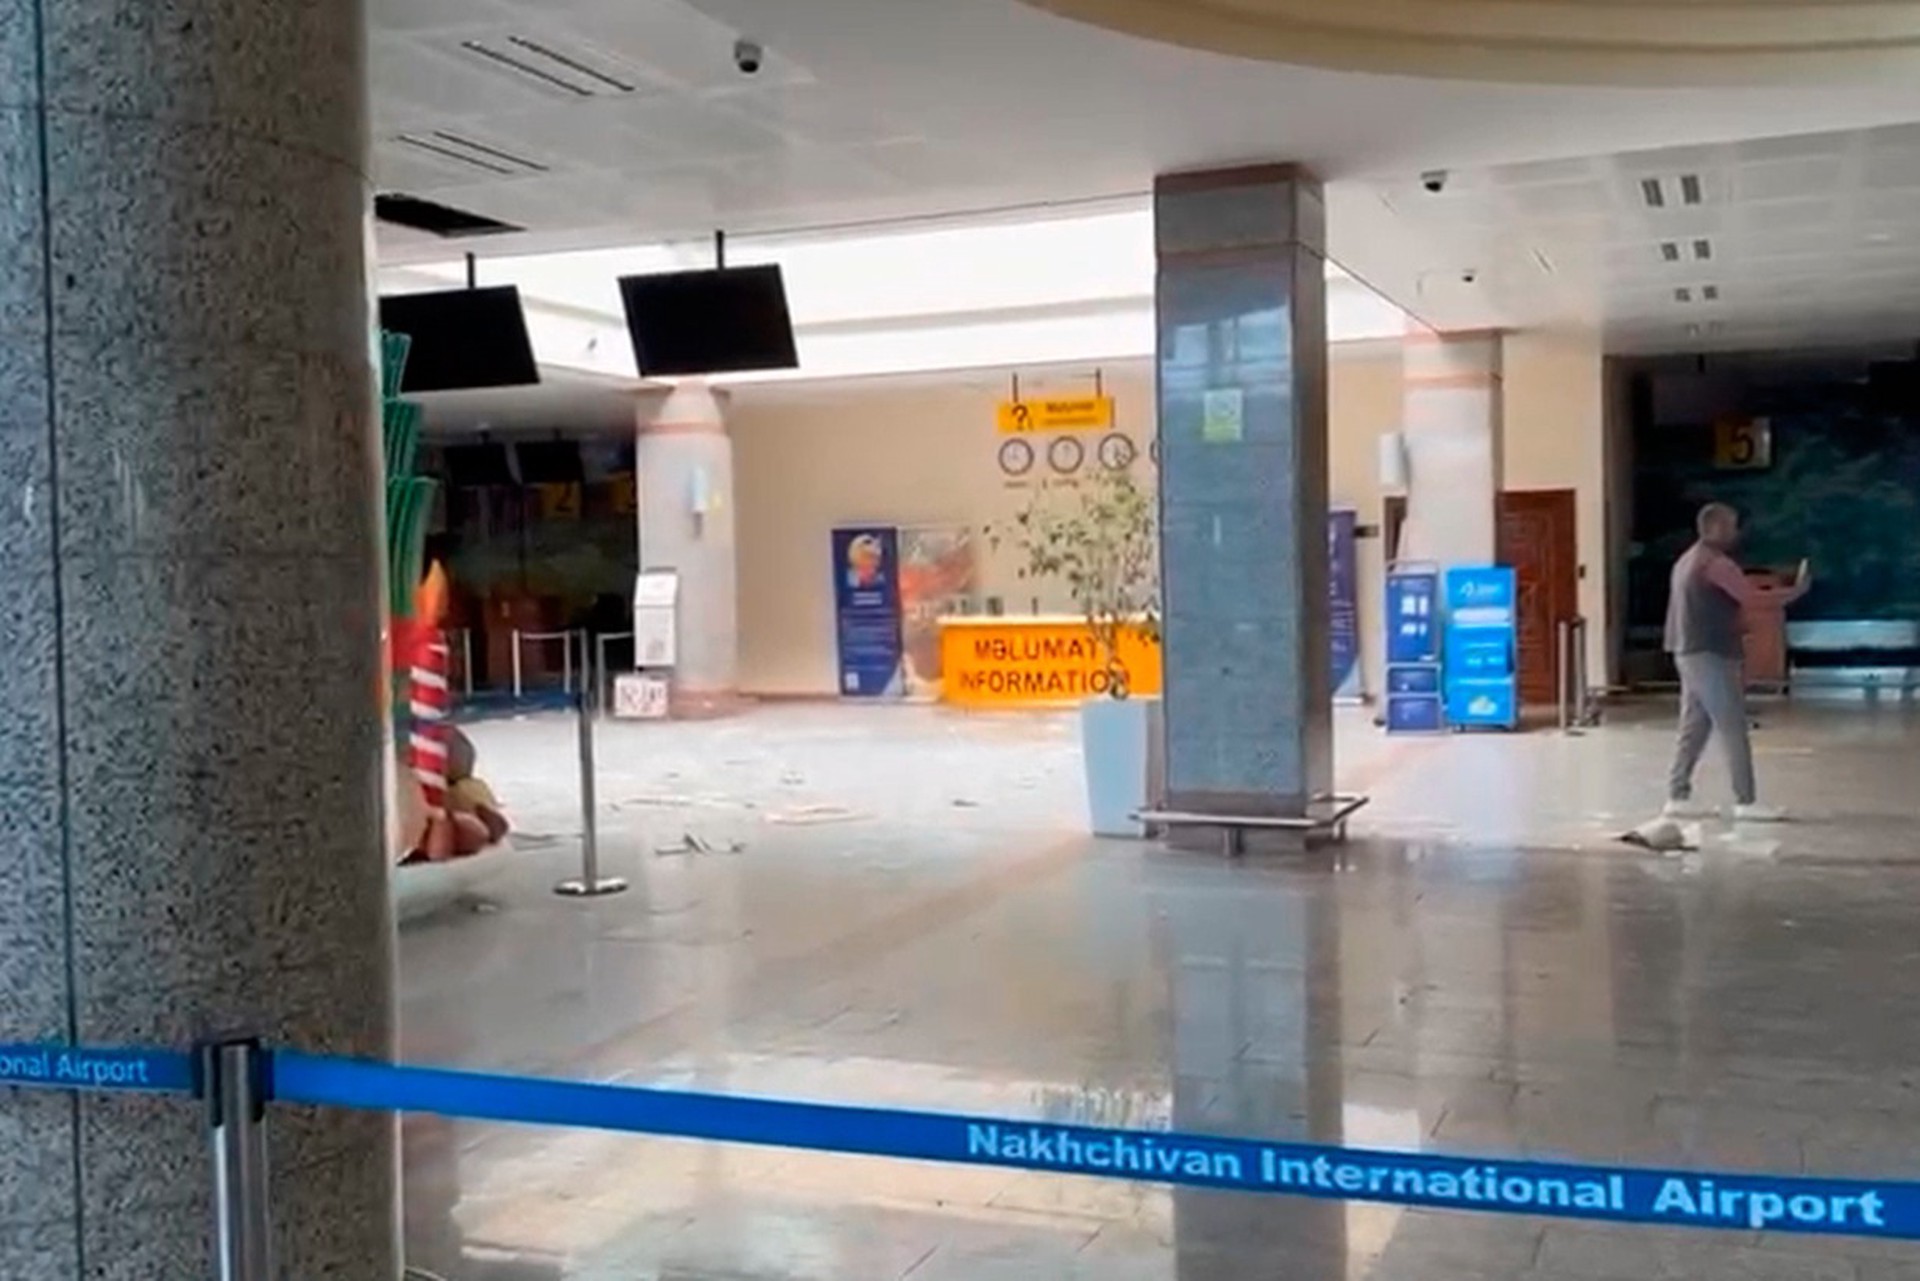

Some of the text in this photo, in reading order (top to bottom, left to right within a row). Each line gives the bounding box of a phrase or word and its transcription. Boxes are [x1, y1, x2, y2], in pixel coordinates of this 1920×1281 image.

[1731, 421, 1754, 465] 5
[56, 1054, 150, 1087] Airport
[966, 1122, 1885, 1228] Nakhchivan International Airport
